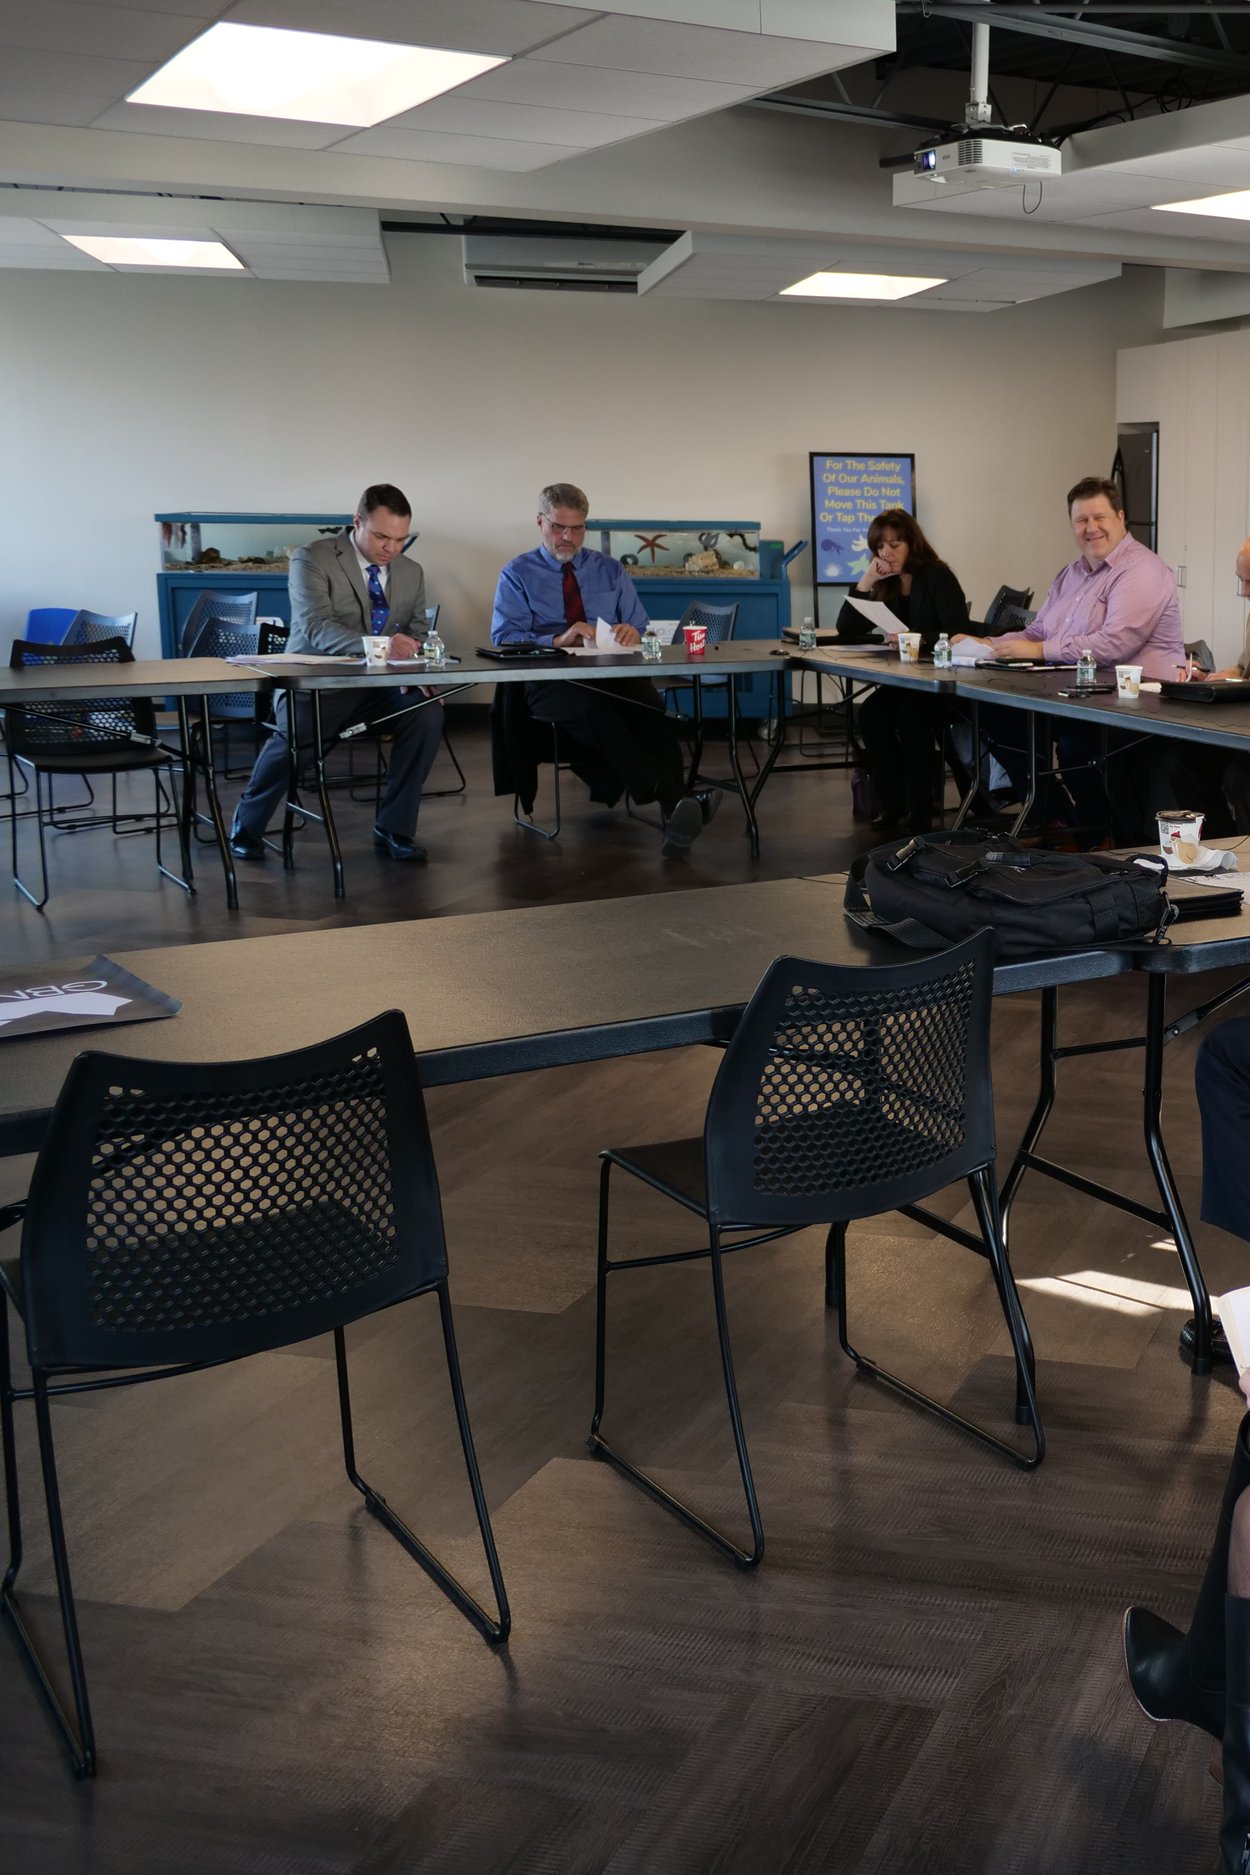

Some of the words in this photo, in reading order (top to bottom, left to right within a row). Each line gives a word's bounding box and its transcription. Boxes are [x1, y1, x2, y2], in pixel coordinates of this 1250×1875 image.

[825, 460, 843, 470] For
[846, 460, 866, 471] The
[868, 460, 901, 472] Safety
[822, 473, 836, 483] Of
[838, 473, 858, 483] Our
[860, 474, 905, 485] Animals,
[827, 486, 861, 497] Please
[864, 487, 879, 497] Do
[881, 487, 902, 497] Not
[825, 499, 853, 509] Move
[855, 499, 877, 509] This
[879, 500, 905, 510] Tank
[819, 512, 833, 522] Or
[836, 512, 855, 524] Tap
